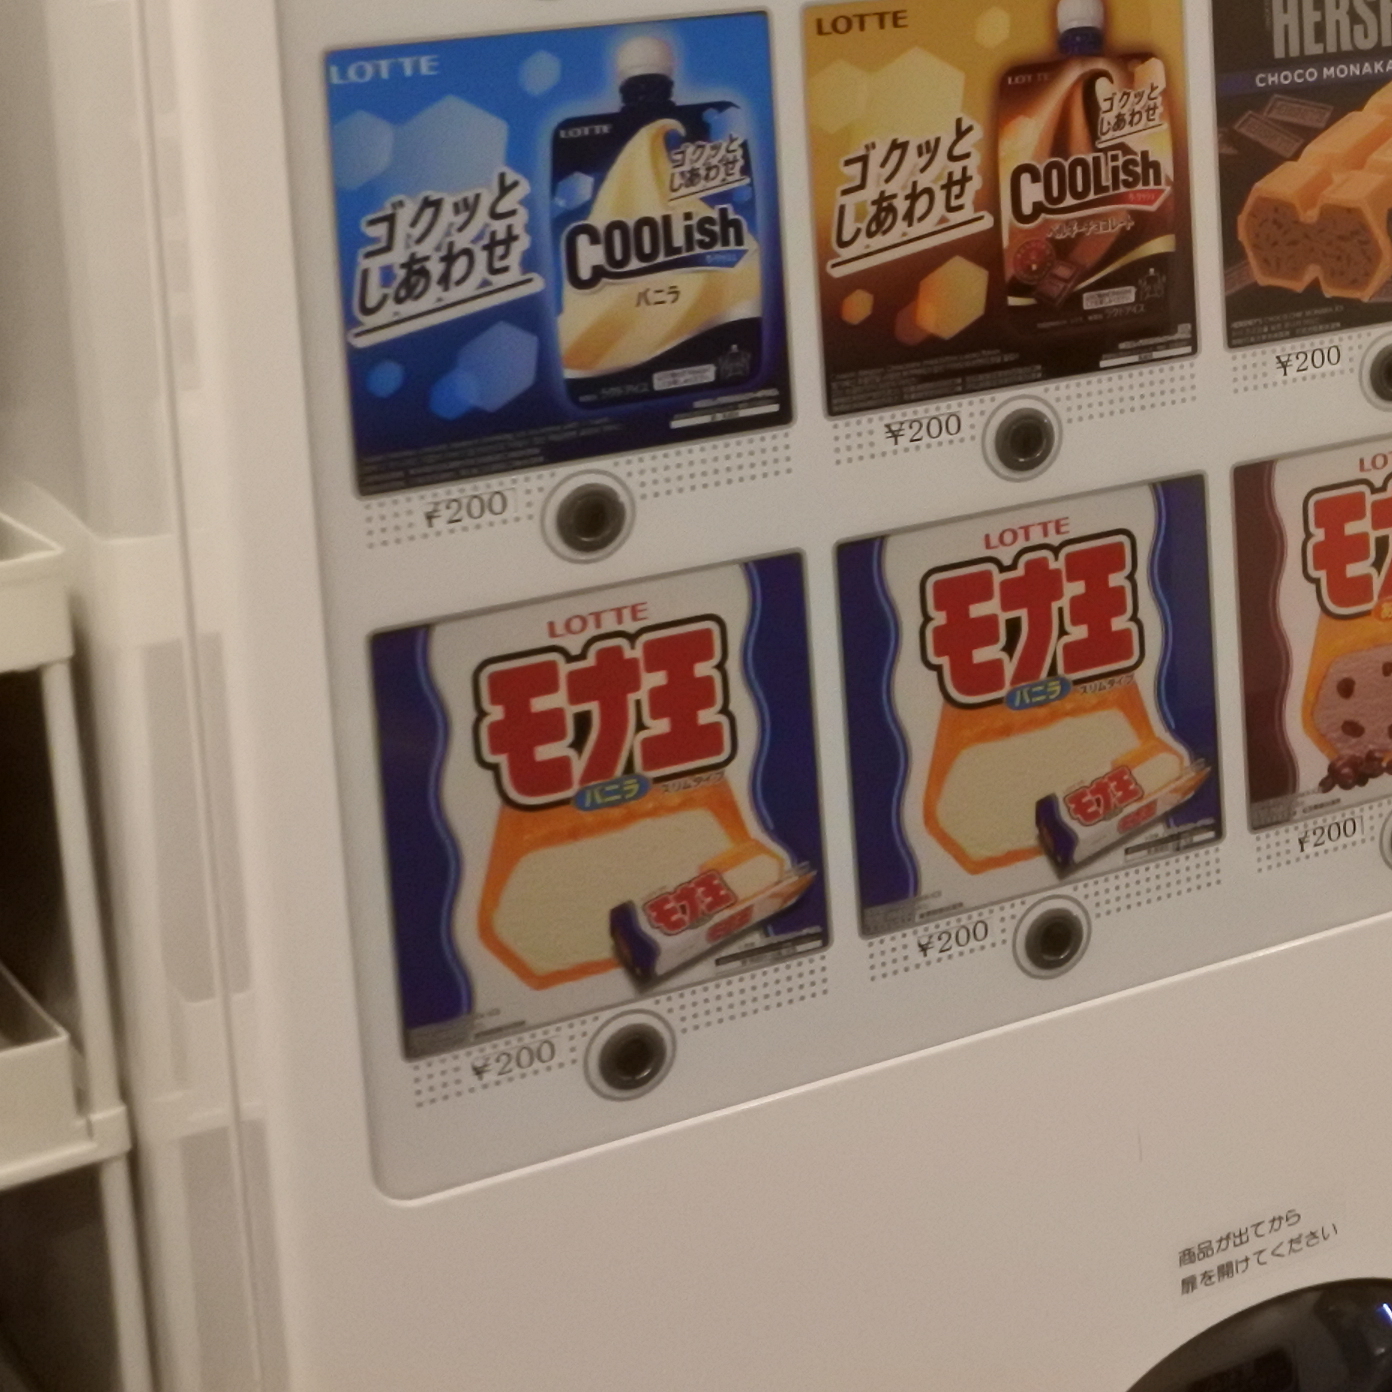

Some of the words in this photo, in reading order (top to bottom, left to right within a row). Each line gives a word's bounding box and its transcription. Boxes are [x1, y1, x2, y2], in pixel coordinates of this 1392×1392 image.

[816, 9, 909, 36] LOTTE
[329, 54, 440, 85] LOTTE
[1254, 69, 1319, 88] CHOCO
[1101, 82, 1162, 114] ゴクッと
[1098, 104, 1160, 137] しあわせ
[670, 134, 741, 170] ゴクッと
[839, 116, 975, 199] ゴクッと
[668, 155, 744, 192] しあわせ
[1009, 149, 1163, 225] COOLish
[362, 170, 522, 260] ゴクッと
[835, 169, 975, 250] しあわせ
[564, 208, 746, 291] COOLish
[358, 230, 521, 318] しあわせ
[635, 285, 681, 308] バニラ
[1275, 344, 1342, 377] ¥200
[884, 412, 963, 446] ¥200
[983, 515, 1071, 551] LOTTE
[547, 601, 649, 639] LOTTE
[932, 540, 1136, 698] モナ王
[1014, 679, 1063, 706] バニラ
[486, 626, 727, 800] モナ王
[583, 777, 641, 807] バニラ
[1065, 766, 1143, 826] モナ王
[645, 870, 738, 935] モナ王
[917, 920, 989, 958] ¥200
[471, 1040, 557, 1082] ¥200
[1177, 1208, 1302, 1269] 商品が出てから
[1180, 1222, 1339, 1297] 扉を開けてください
